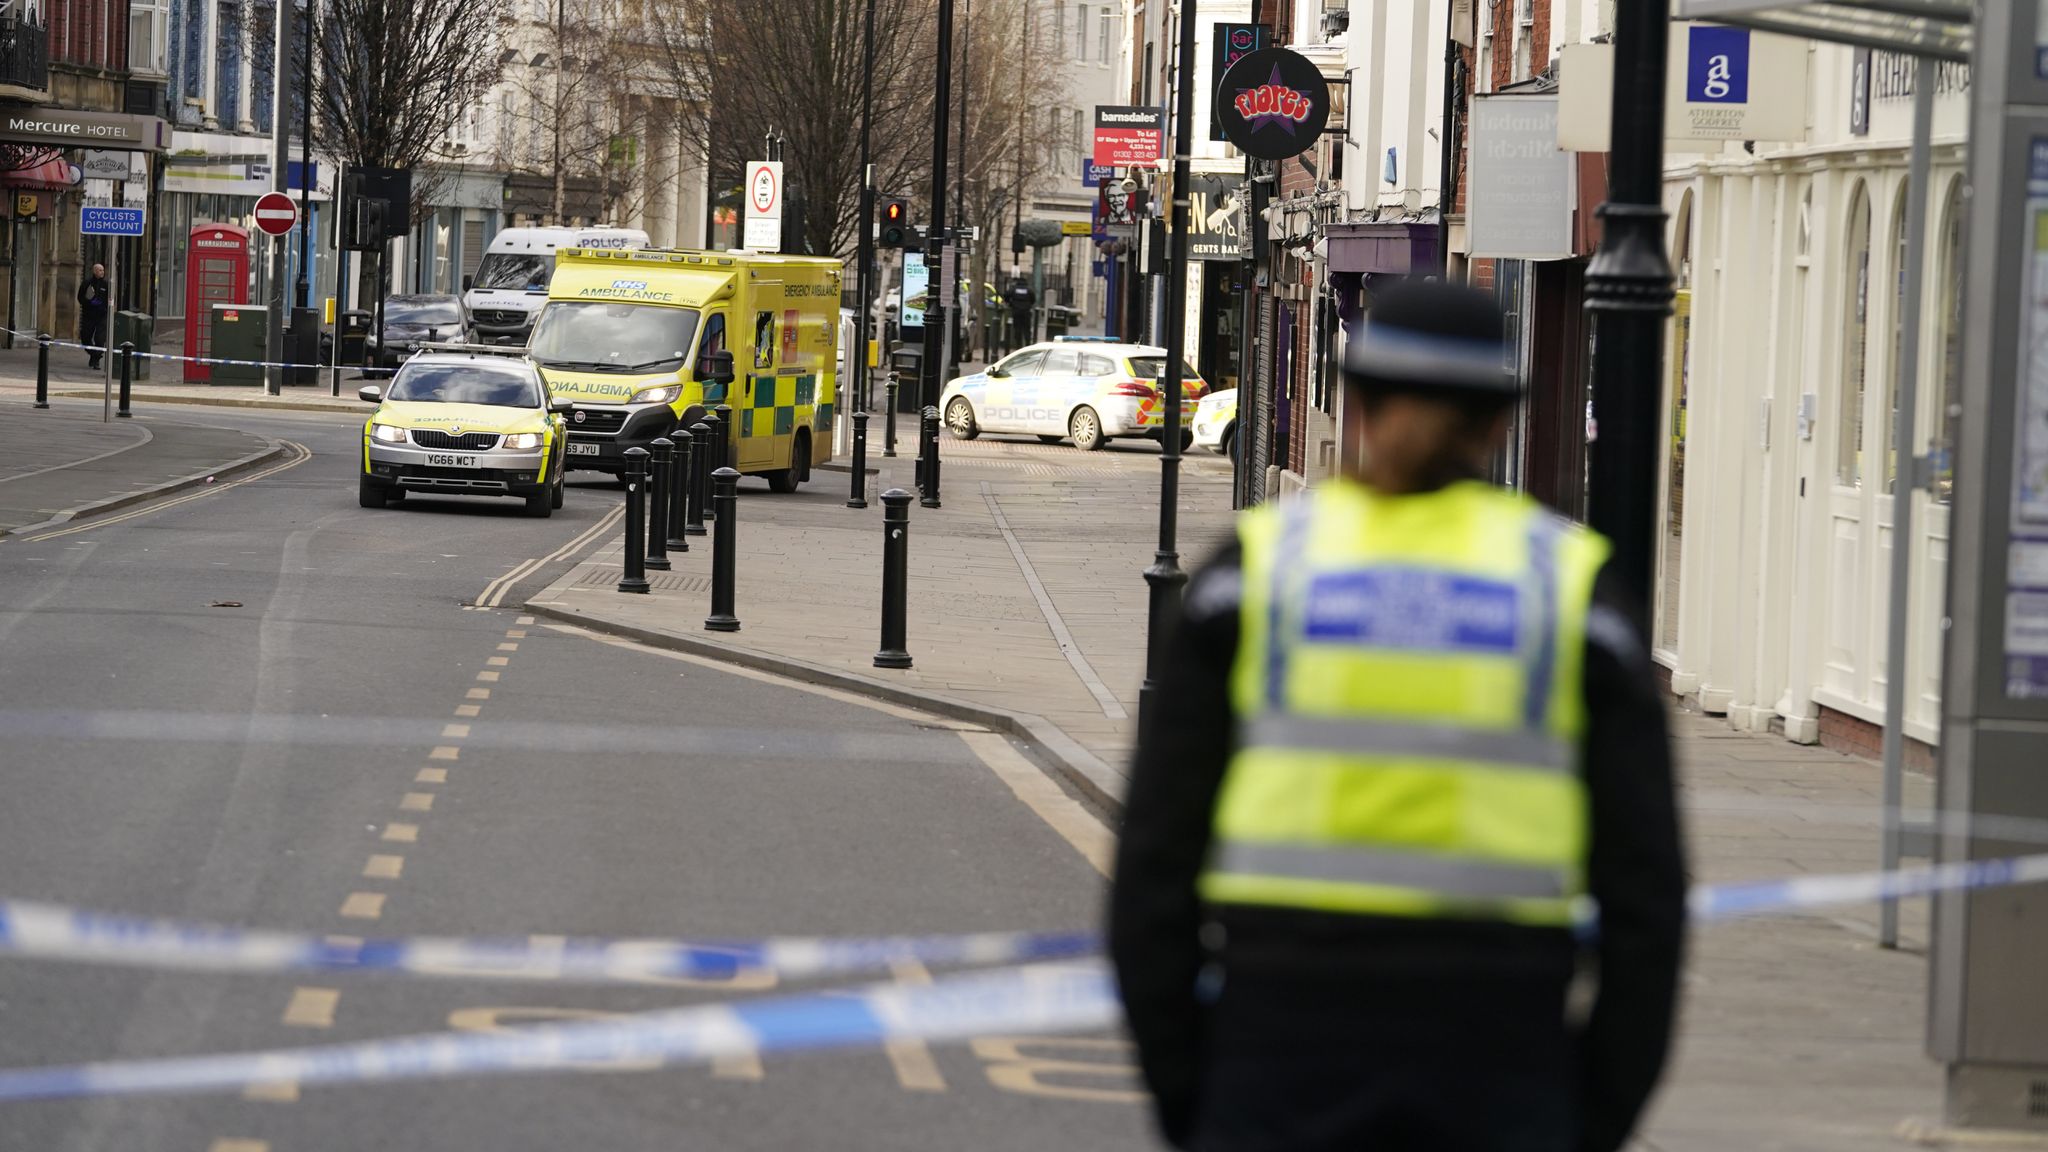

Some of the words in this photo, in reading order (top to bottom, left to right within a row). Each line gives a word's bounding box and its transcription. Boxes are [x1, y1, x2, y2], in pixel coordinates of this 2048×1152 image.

[1231, 32, 1253, 44] bar
[1234, 84, 1312, 122] flares
[9, 118, 81, 134] Mercure
[87, 125, 129, 138] HOTEL
[1146, 130, 1157, 138] Let
[1089, 165, 1111, 174] CASH
[89, 211, 136, 221] CYCLISTS
[85, 220, 140, 231] DISMOUNT
[582, 237, 628, 248] POLICE
[1193, 244, 1219, 254] GENTS
[1221, 244, 1241, 254] BAR
[613, 280, 646, 289] NHS
[784, 284, 810, 297] EMERGENCY
[811, 283, 838, 297] AMBULANCE
[579, 288, 673, 302] AMBULANCE
[983, 407, 1061, 421] POLICE
[579, 445, 596, 454] JYU
[427, 454, 454, 466] YG66
[457, 456, 475, 466] WCT
